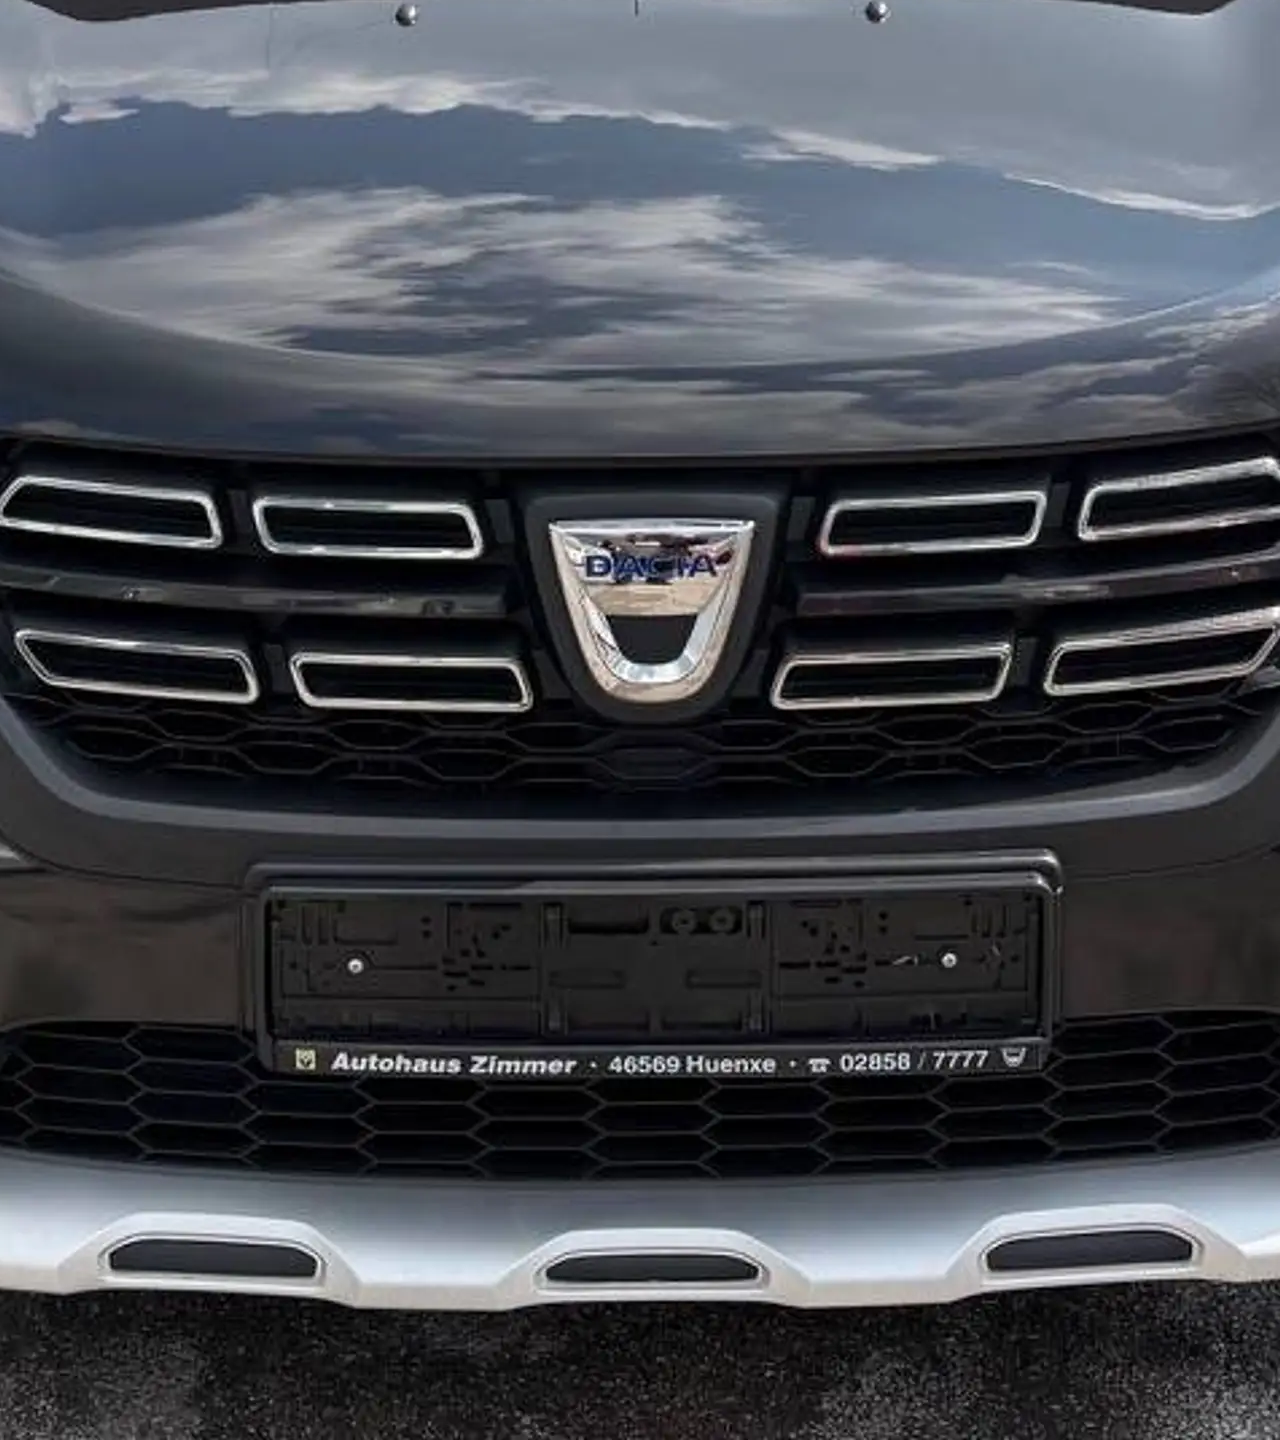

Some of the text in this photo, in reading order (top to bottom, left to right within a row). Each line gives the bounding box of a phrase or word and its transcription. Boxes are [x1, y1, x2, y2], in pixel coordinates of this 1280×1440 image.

[584, 554, 718, 579] DACIA
[330, 1051, 461, 1074] Autohaus
[469, 1054, 577, 1075] Zimmer
[607, 1055, 680, 1074] 46569
[685, 1055, 777, 1074] Huenxe
[839, 1051, 911, 1073] 02858
[932, 1049, 989, 1071] 7777
